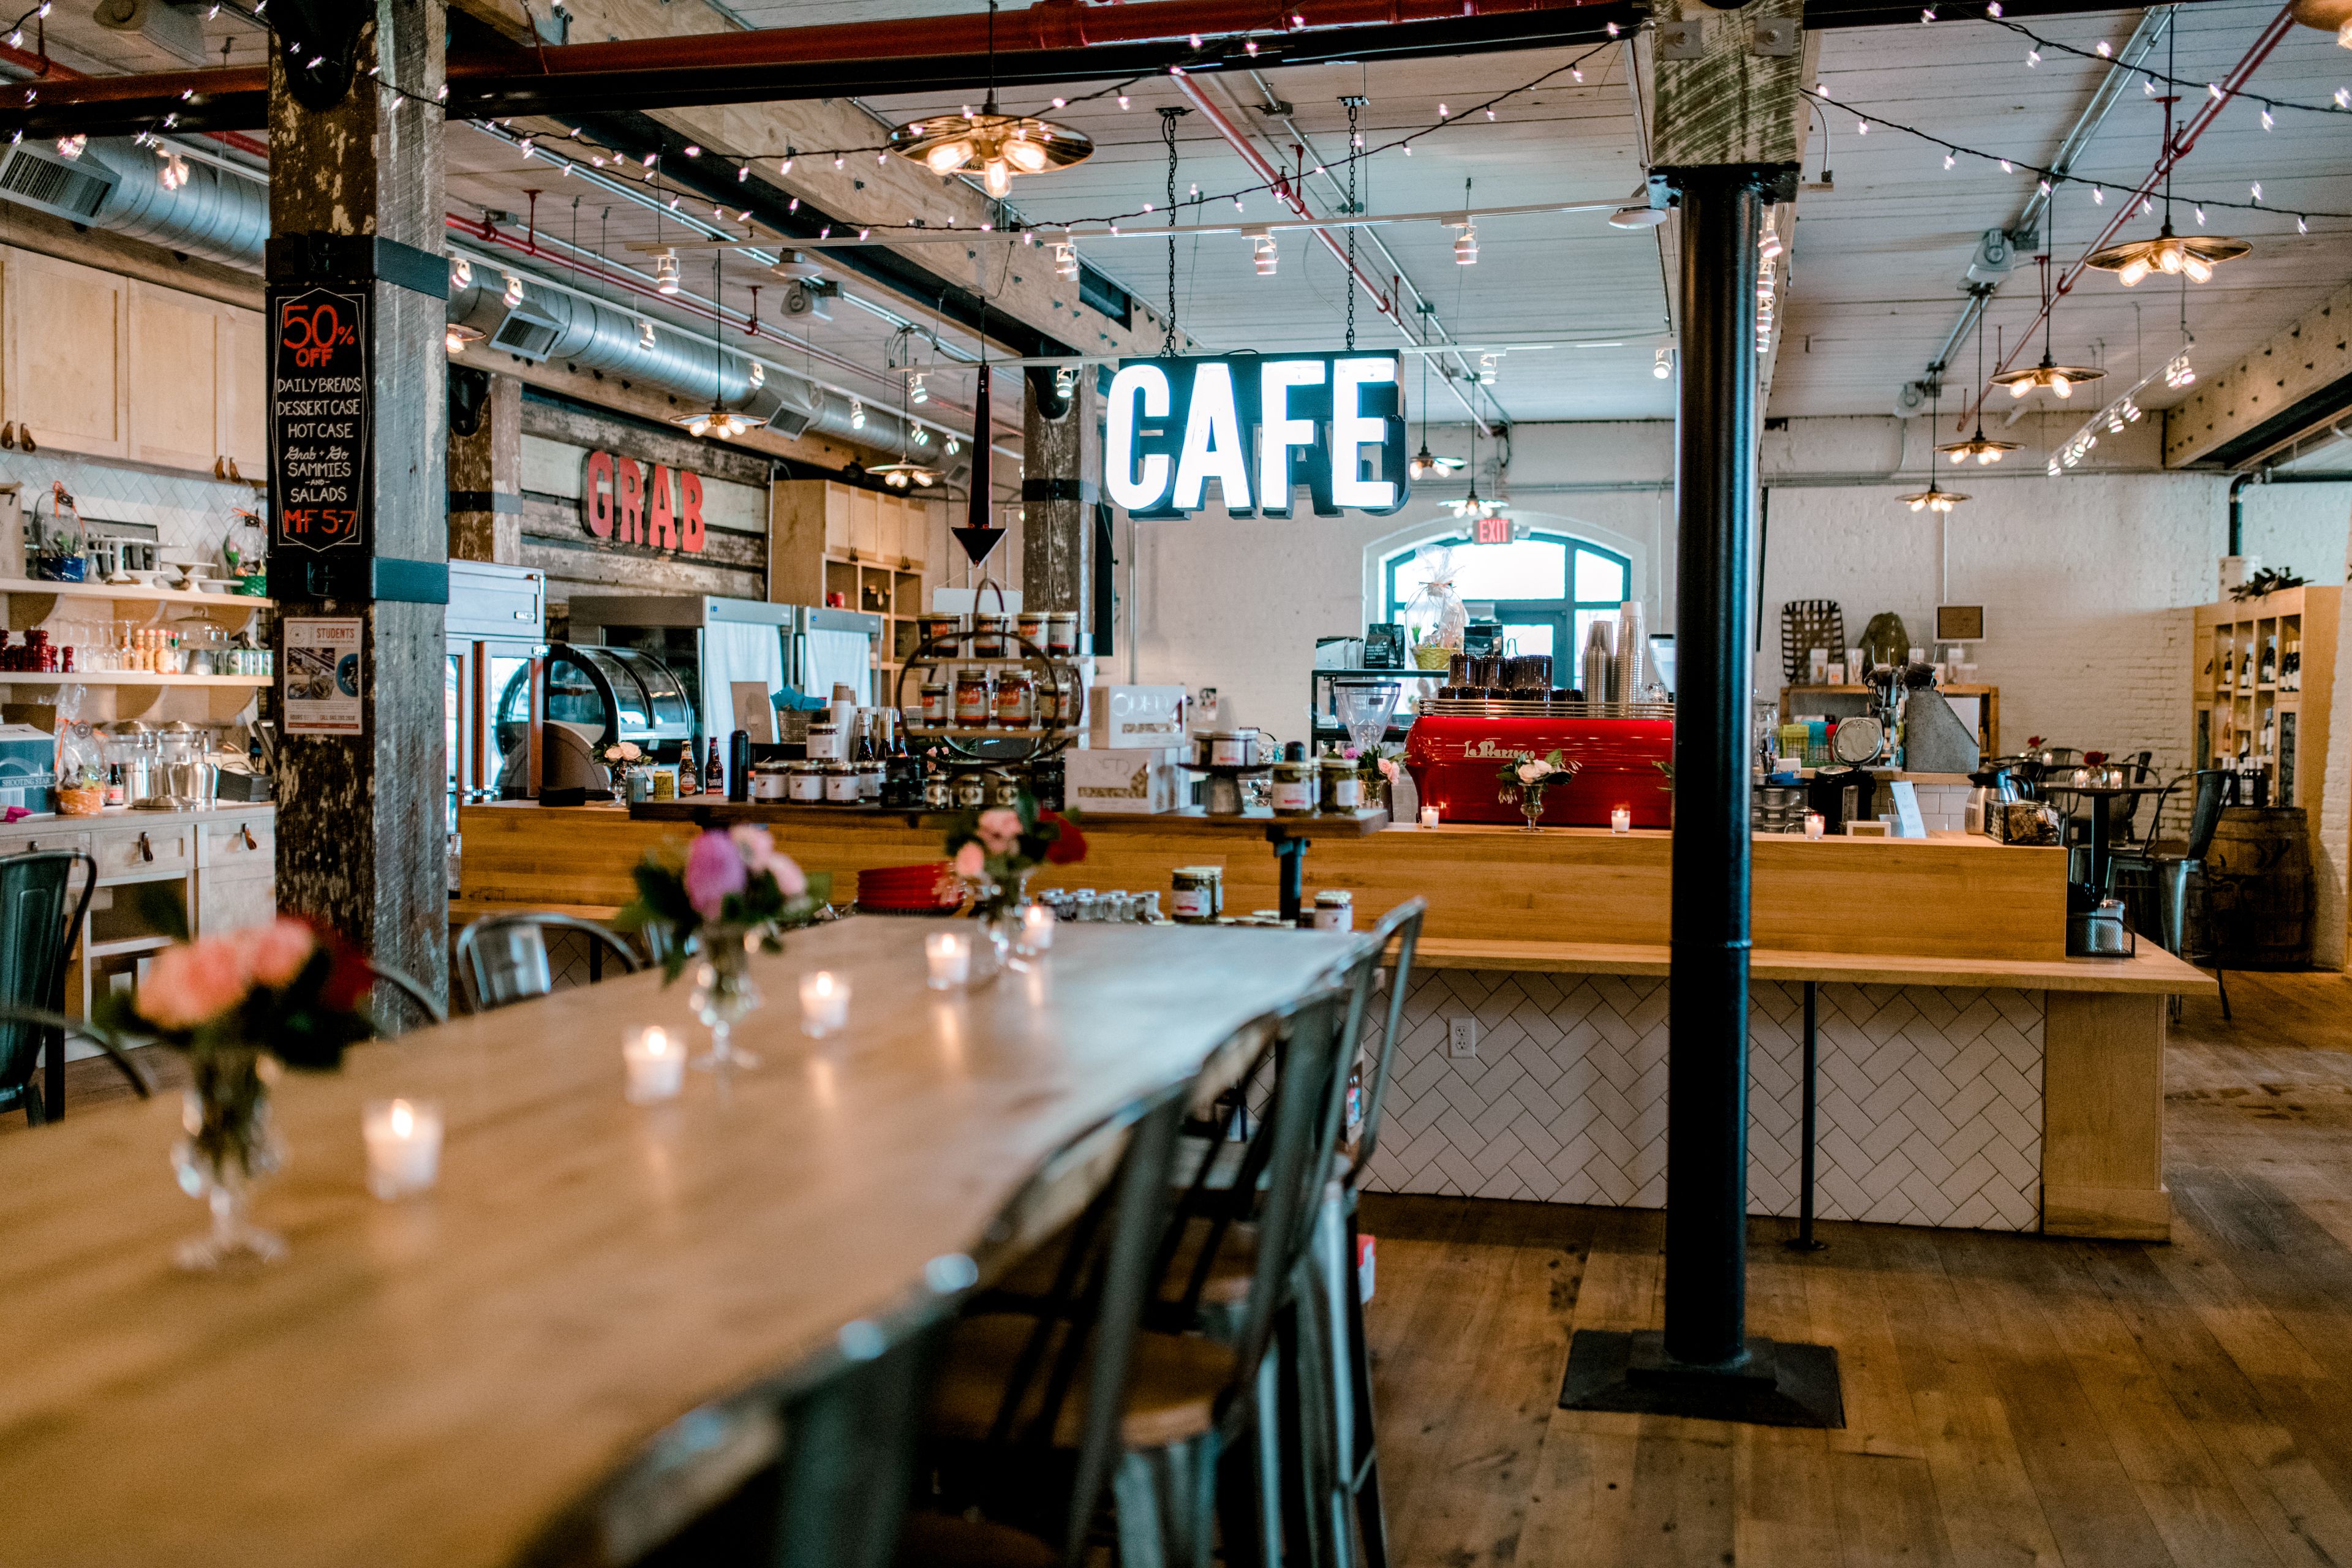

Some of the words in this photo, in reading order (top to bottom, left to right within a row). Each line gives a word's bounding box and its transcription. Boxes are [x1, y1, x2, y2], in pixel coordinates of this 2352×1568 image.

[283, 304, 355, 349] 50%
[296, 348, 334, 368] OFF
[277, 377, 317, 393] DAILY
[318, 377, 361, 393] BREADS
[277, 399, 330, 416] DESSERT
[330, 399, 360, 415] CASE
[288, 423, 316, 438] HOT
[317, 423, 353, 438] CASE
[1106, 358, 1396, 510] CAFE
[284, 446, 317, 461] Grab
[326, 446, 350, 460] Go
[287, 462, 352, 478] SAMMIES
[290, 487, 347, 502] SALADS
[584, 450, 705, 552] GRAB
[1479, 519, 1509, 543] EXIT
[316, 627, 355, 639] STUDENTS
[2, 778, 34, 787] SHOOTING
